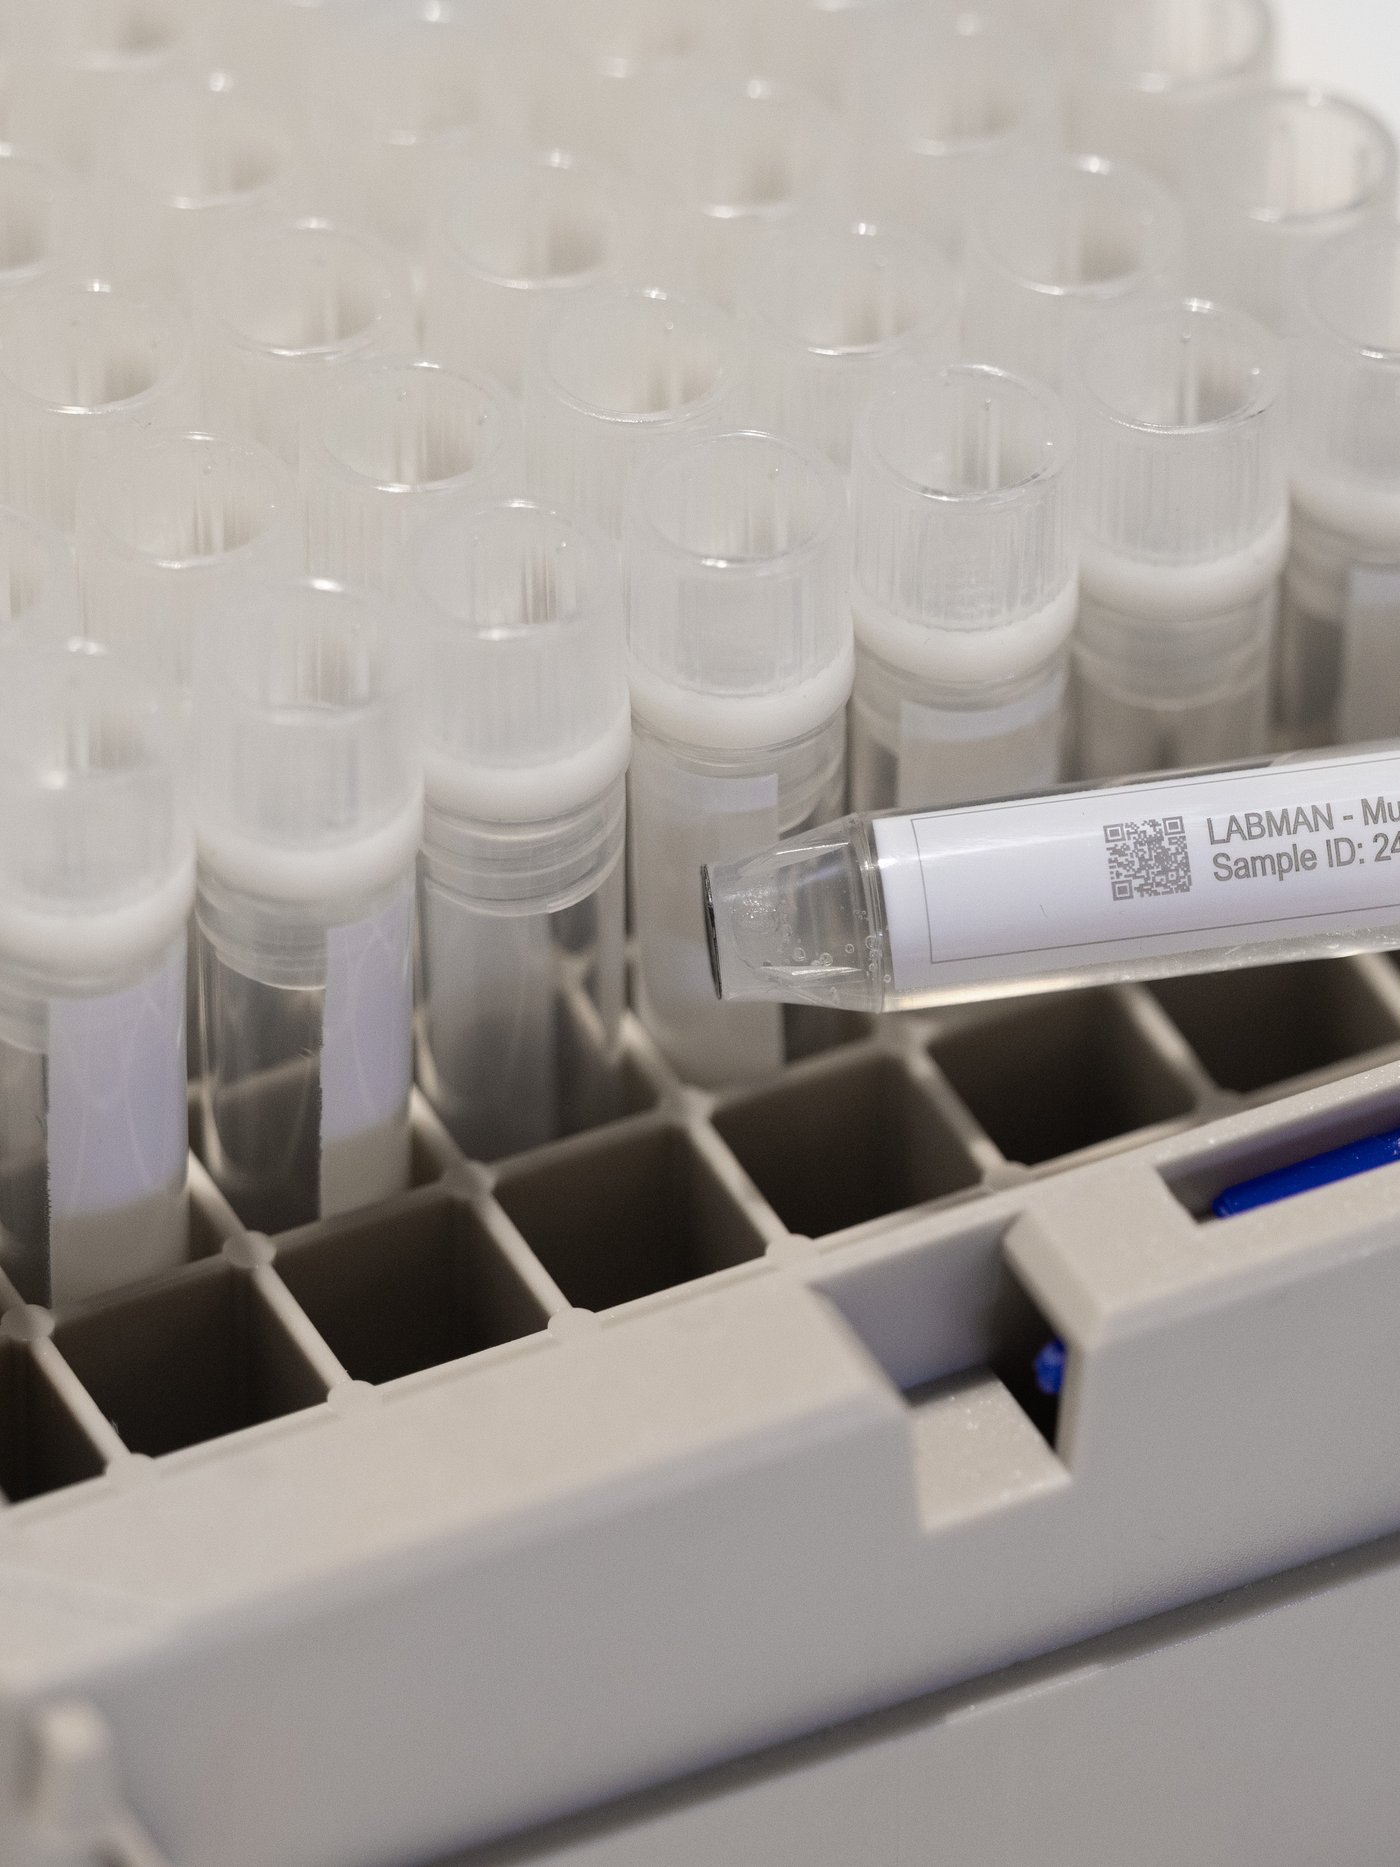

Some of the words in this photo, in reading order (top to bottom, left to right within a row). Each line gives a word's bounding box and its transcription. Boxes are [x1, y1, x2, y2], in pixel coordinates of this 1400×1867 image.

[1207, 802, 1335, 846] LABMAN
[1212, 844, 1318, 882] Sample
[1326, 837, 1365, 868] ID:
